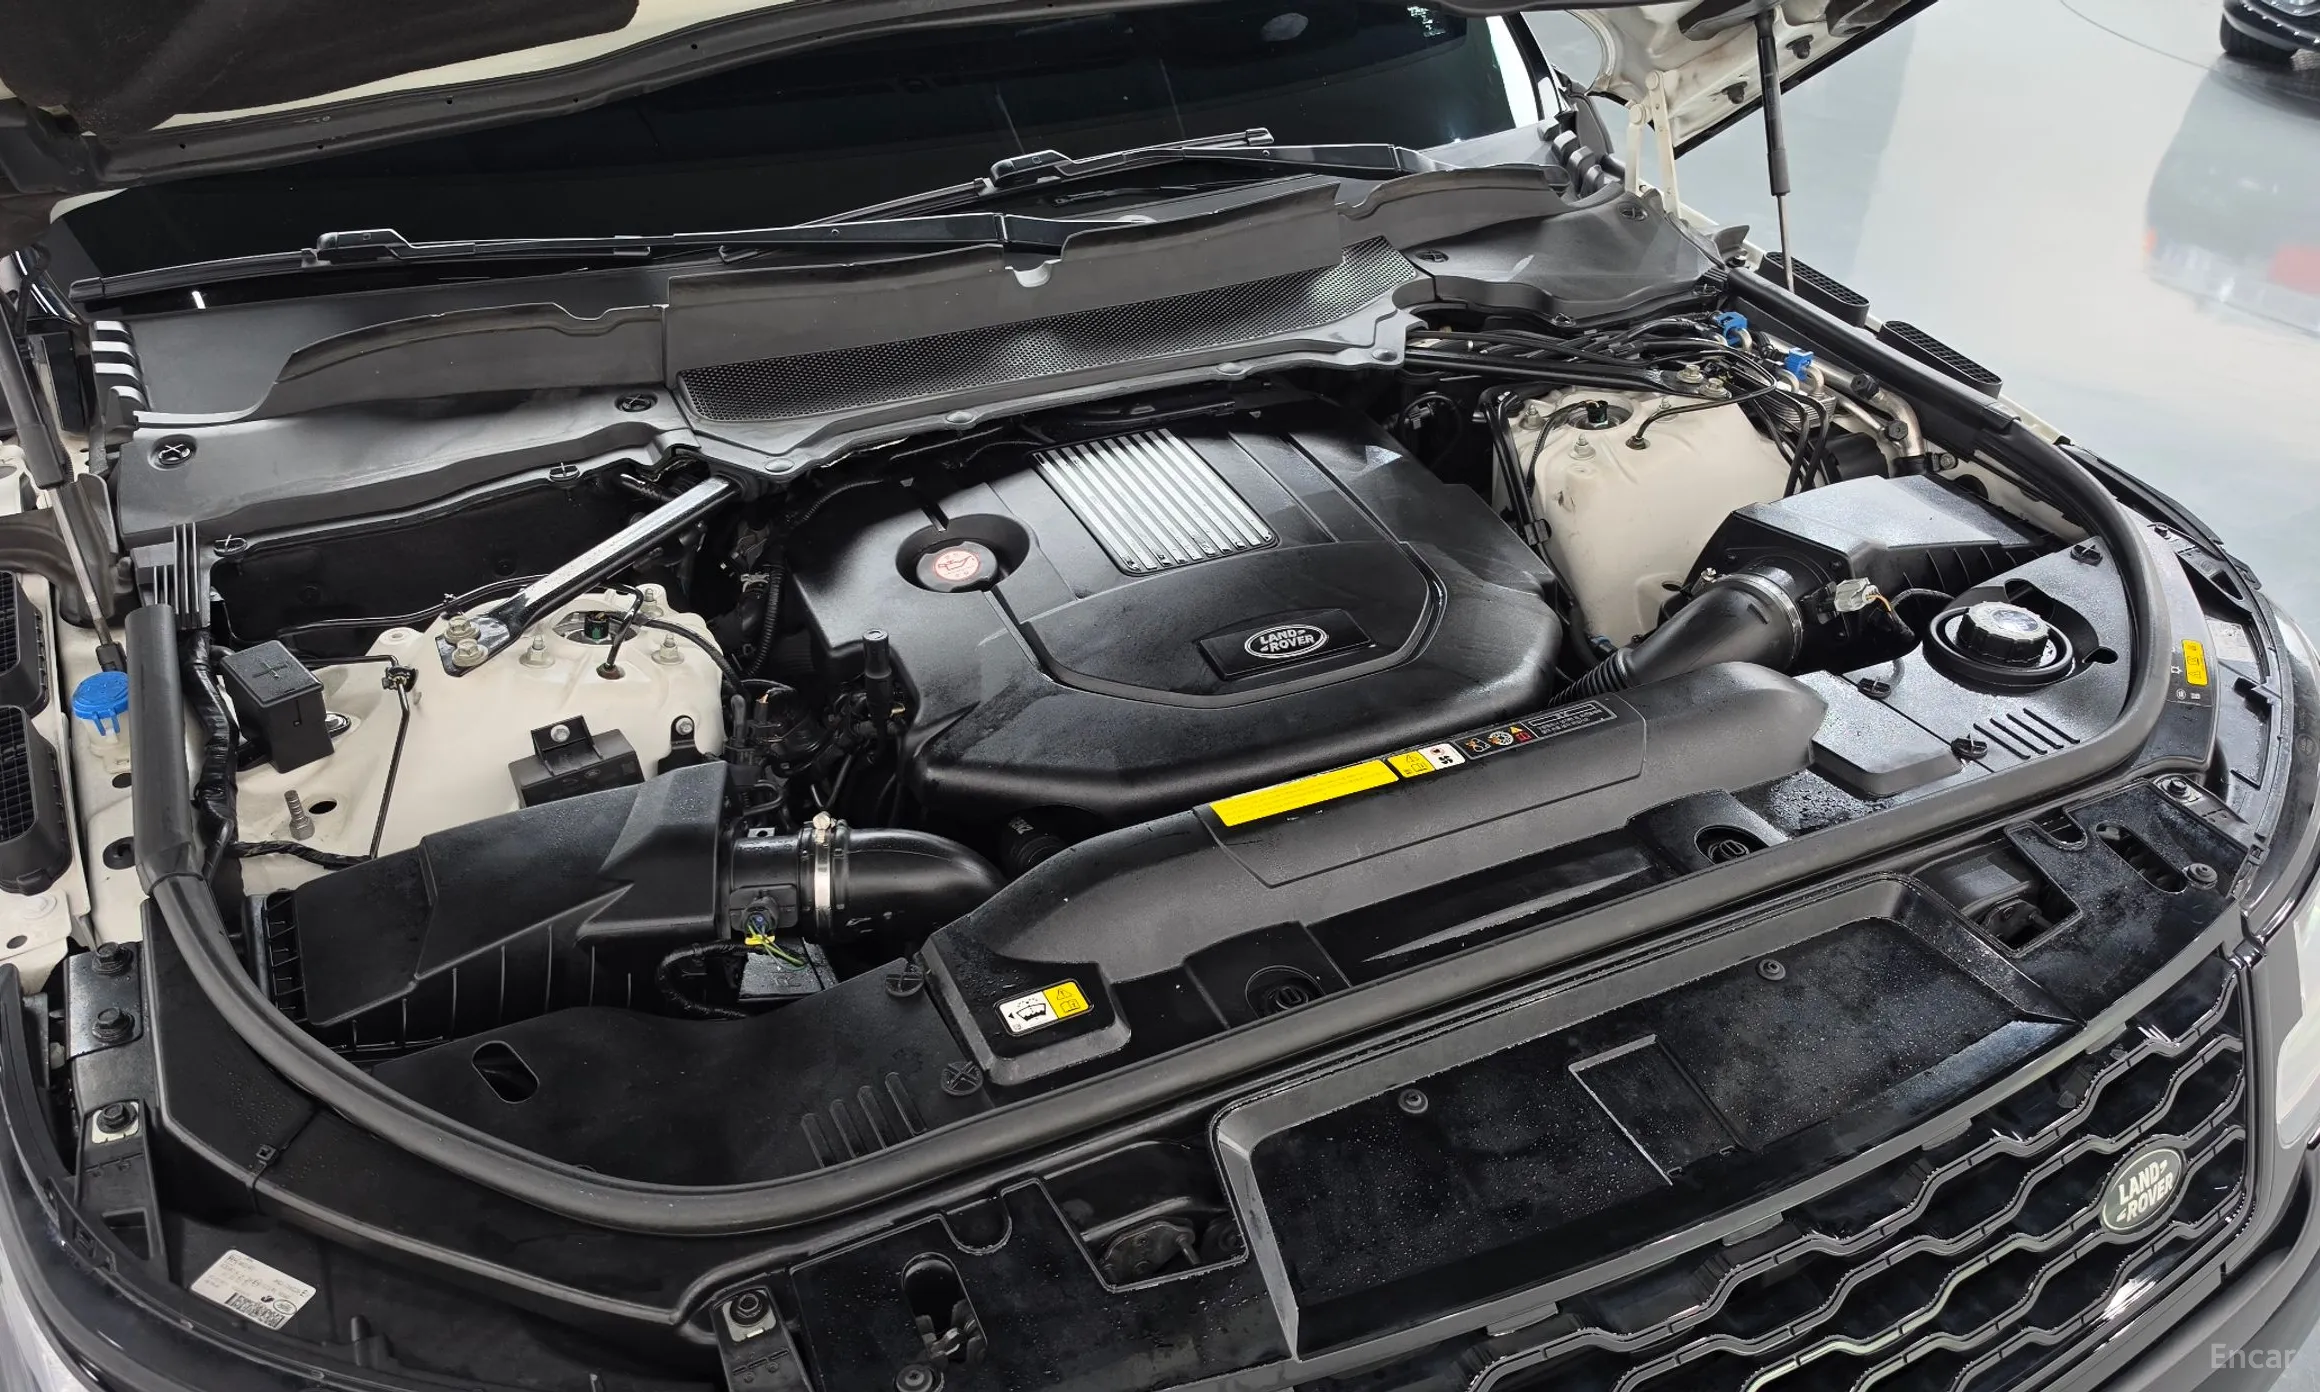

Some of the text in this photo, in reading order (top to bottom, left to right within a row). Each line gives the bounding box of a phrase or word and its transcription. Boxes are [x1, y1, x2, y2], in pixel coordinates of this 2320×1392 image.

[1260, 629, 1297, 645] LAND
[1269, 634, 1315, 652] ROVER
[2118, 1161, 2160, 1206] LAND
[2126, 1171, 2174, 1222] ROVER
